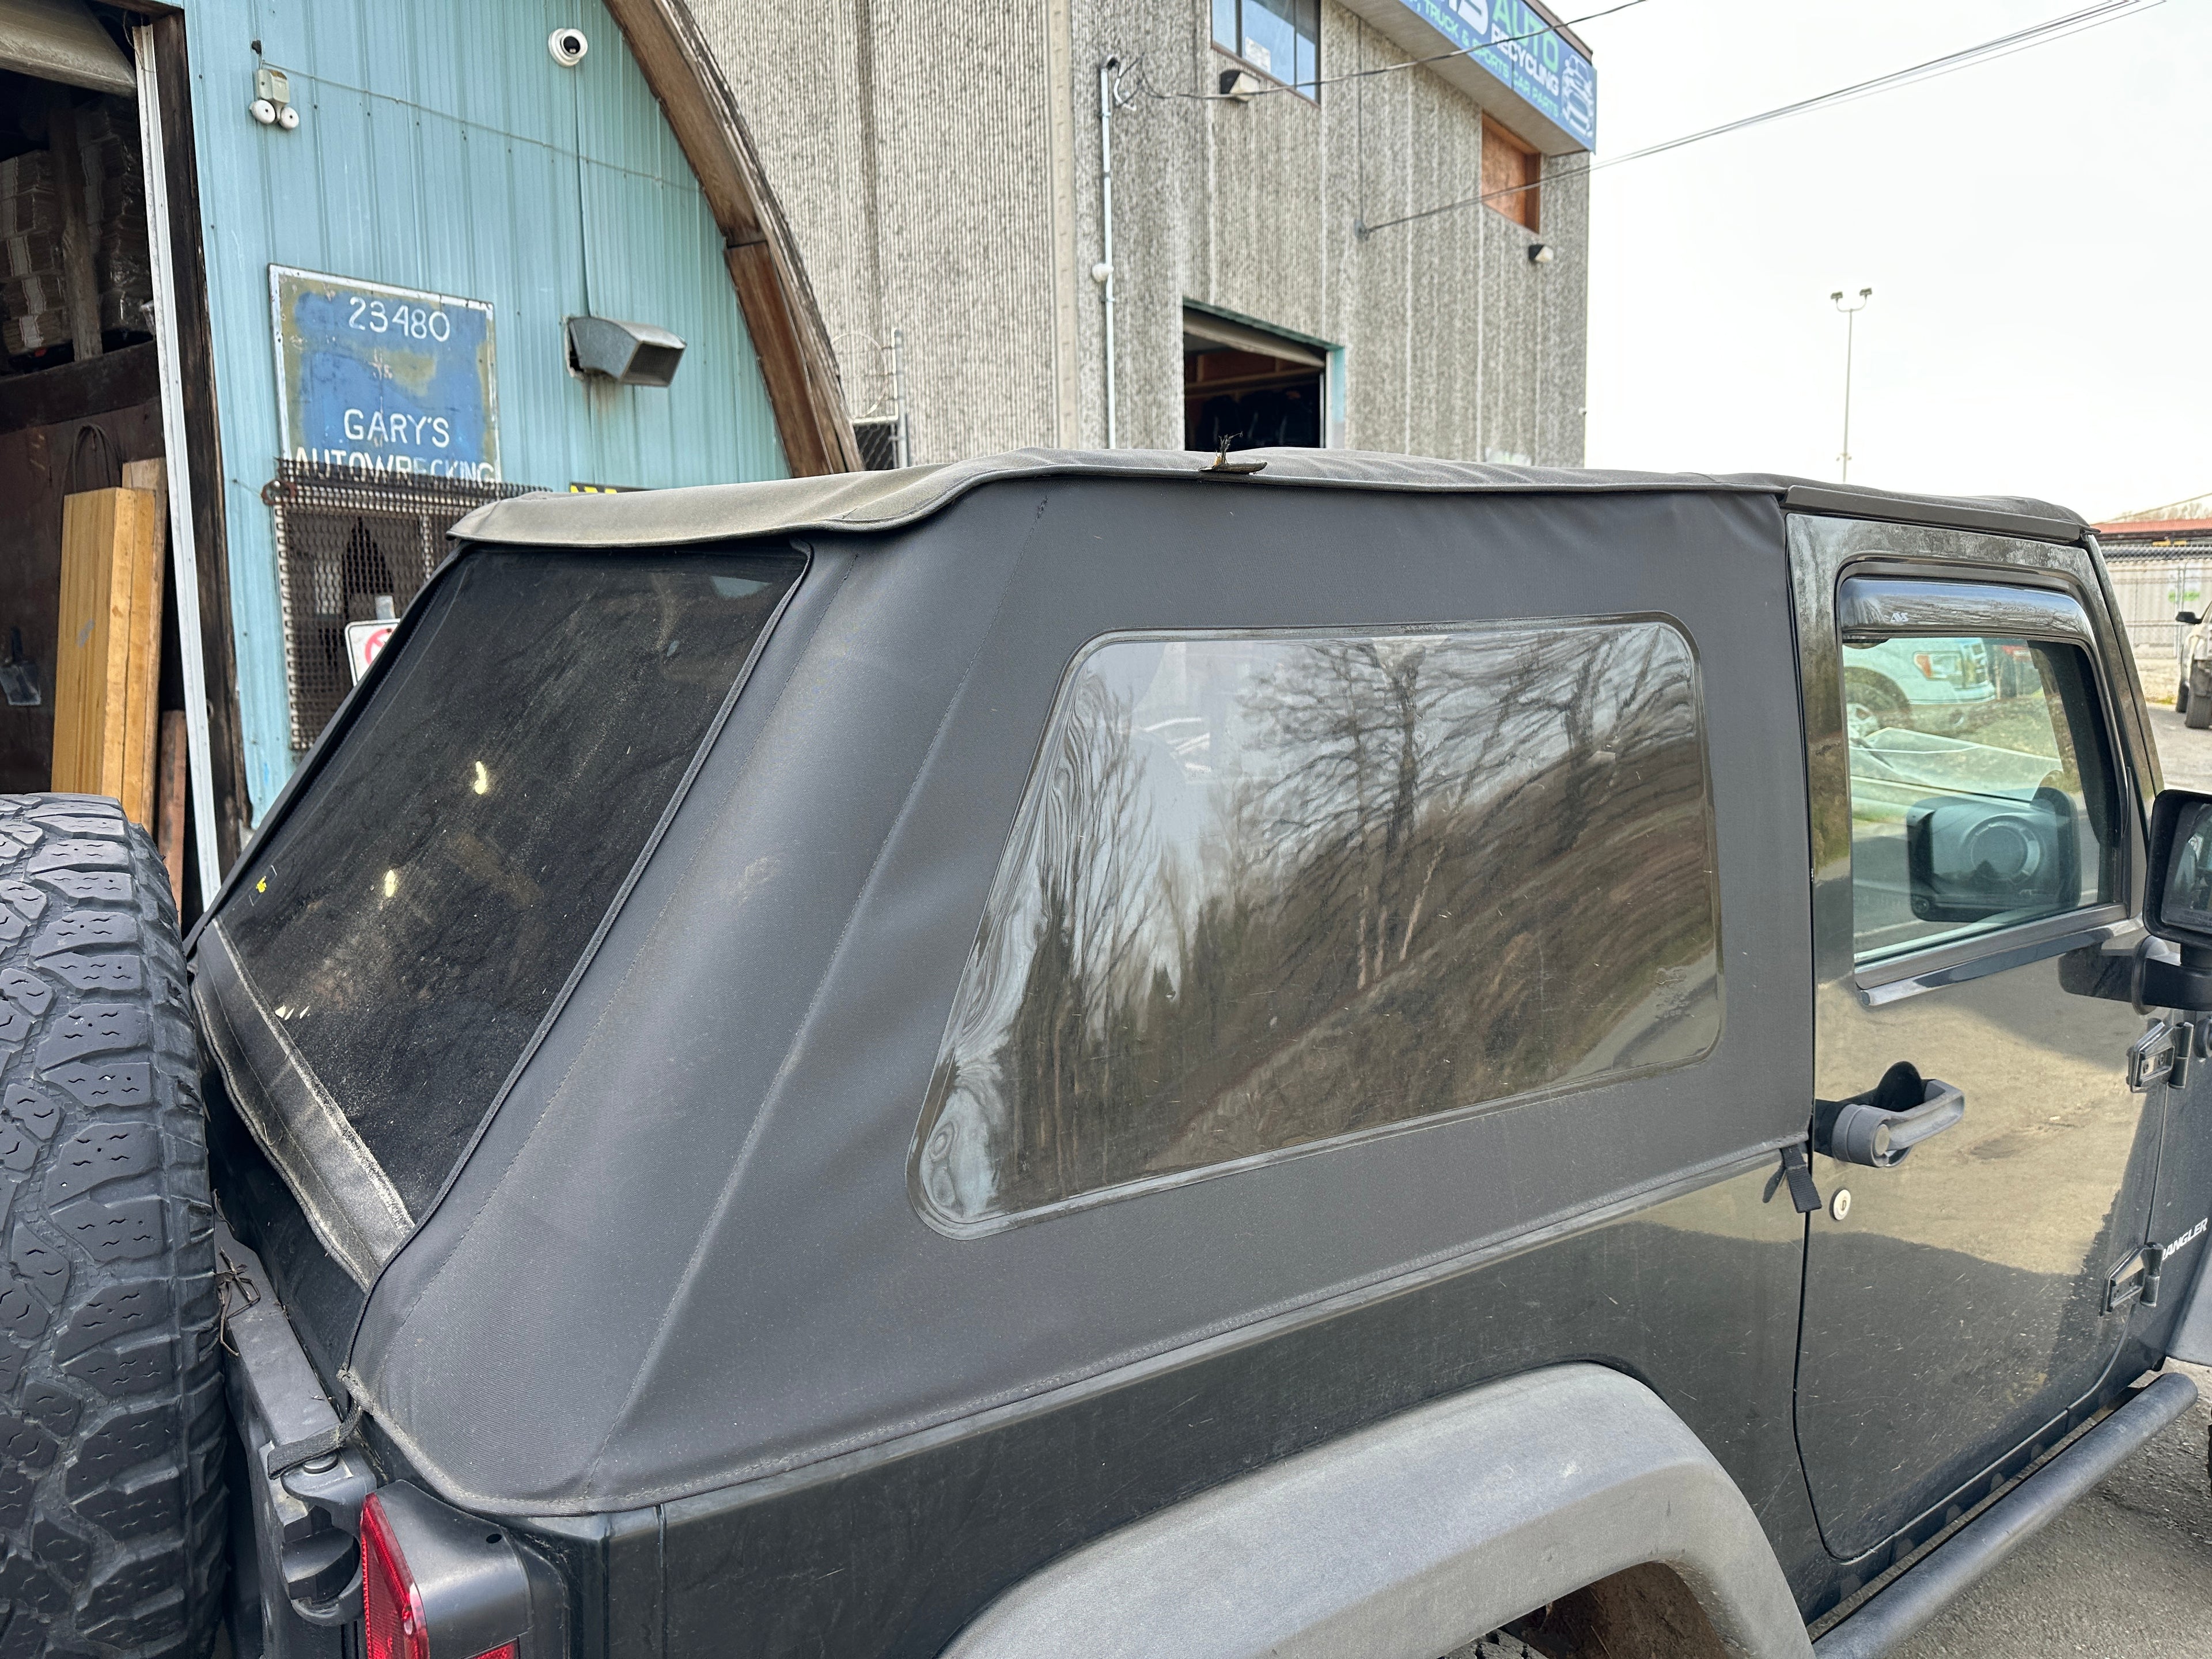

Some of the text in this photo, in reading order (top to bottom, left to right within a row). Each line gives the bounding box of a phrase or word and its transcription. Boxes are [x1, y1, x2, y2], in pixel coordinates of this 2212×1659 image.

[1424, 0, 1459, 39] TRUCK
[1472, 38, 1509, 79] SPORTS
[1513, 70, 1531, 96] CAR
[1532, 86, 1559, 118] PARTS
[1491, 23, 1559, 96] RECYCLING
[1492, 0, 1559, 73] AUTO
[349, 296, 450, 342] 23480
[344, 408, 450, 448] GARY'S
[2161, 1217, 2208, 1261] ANGLER
